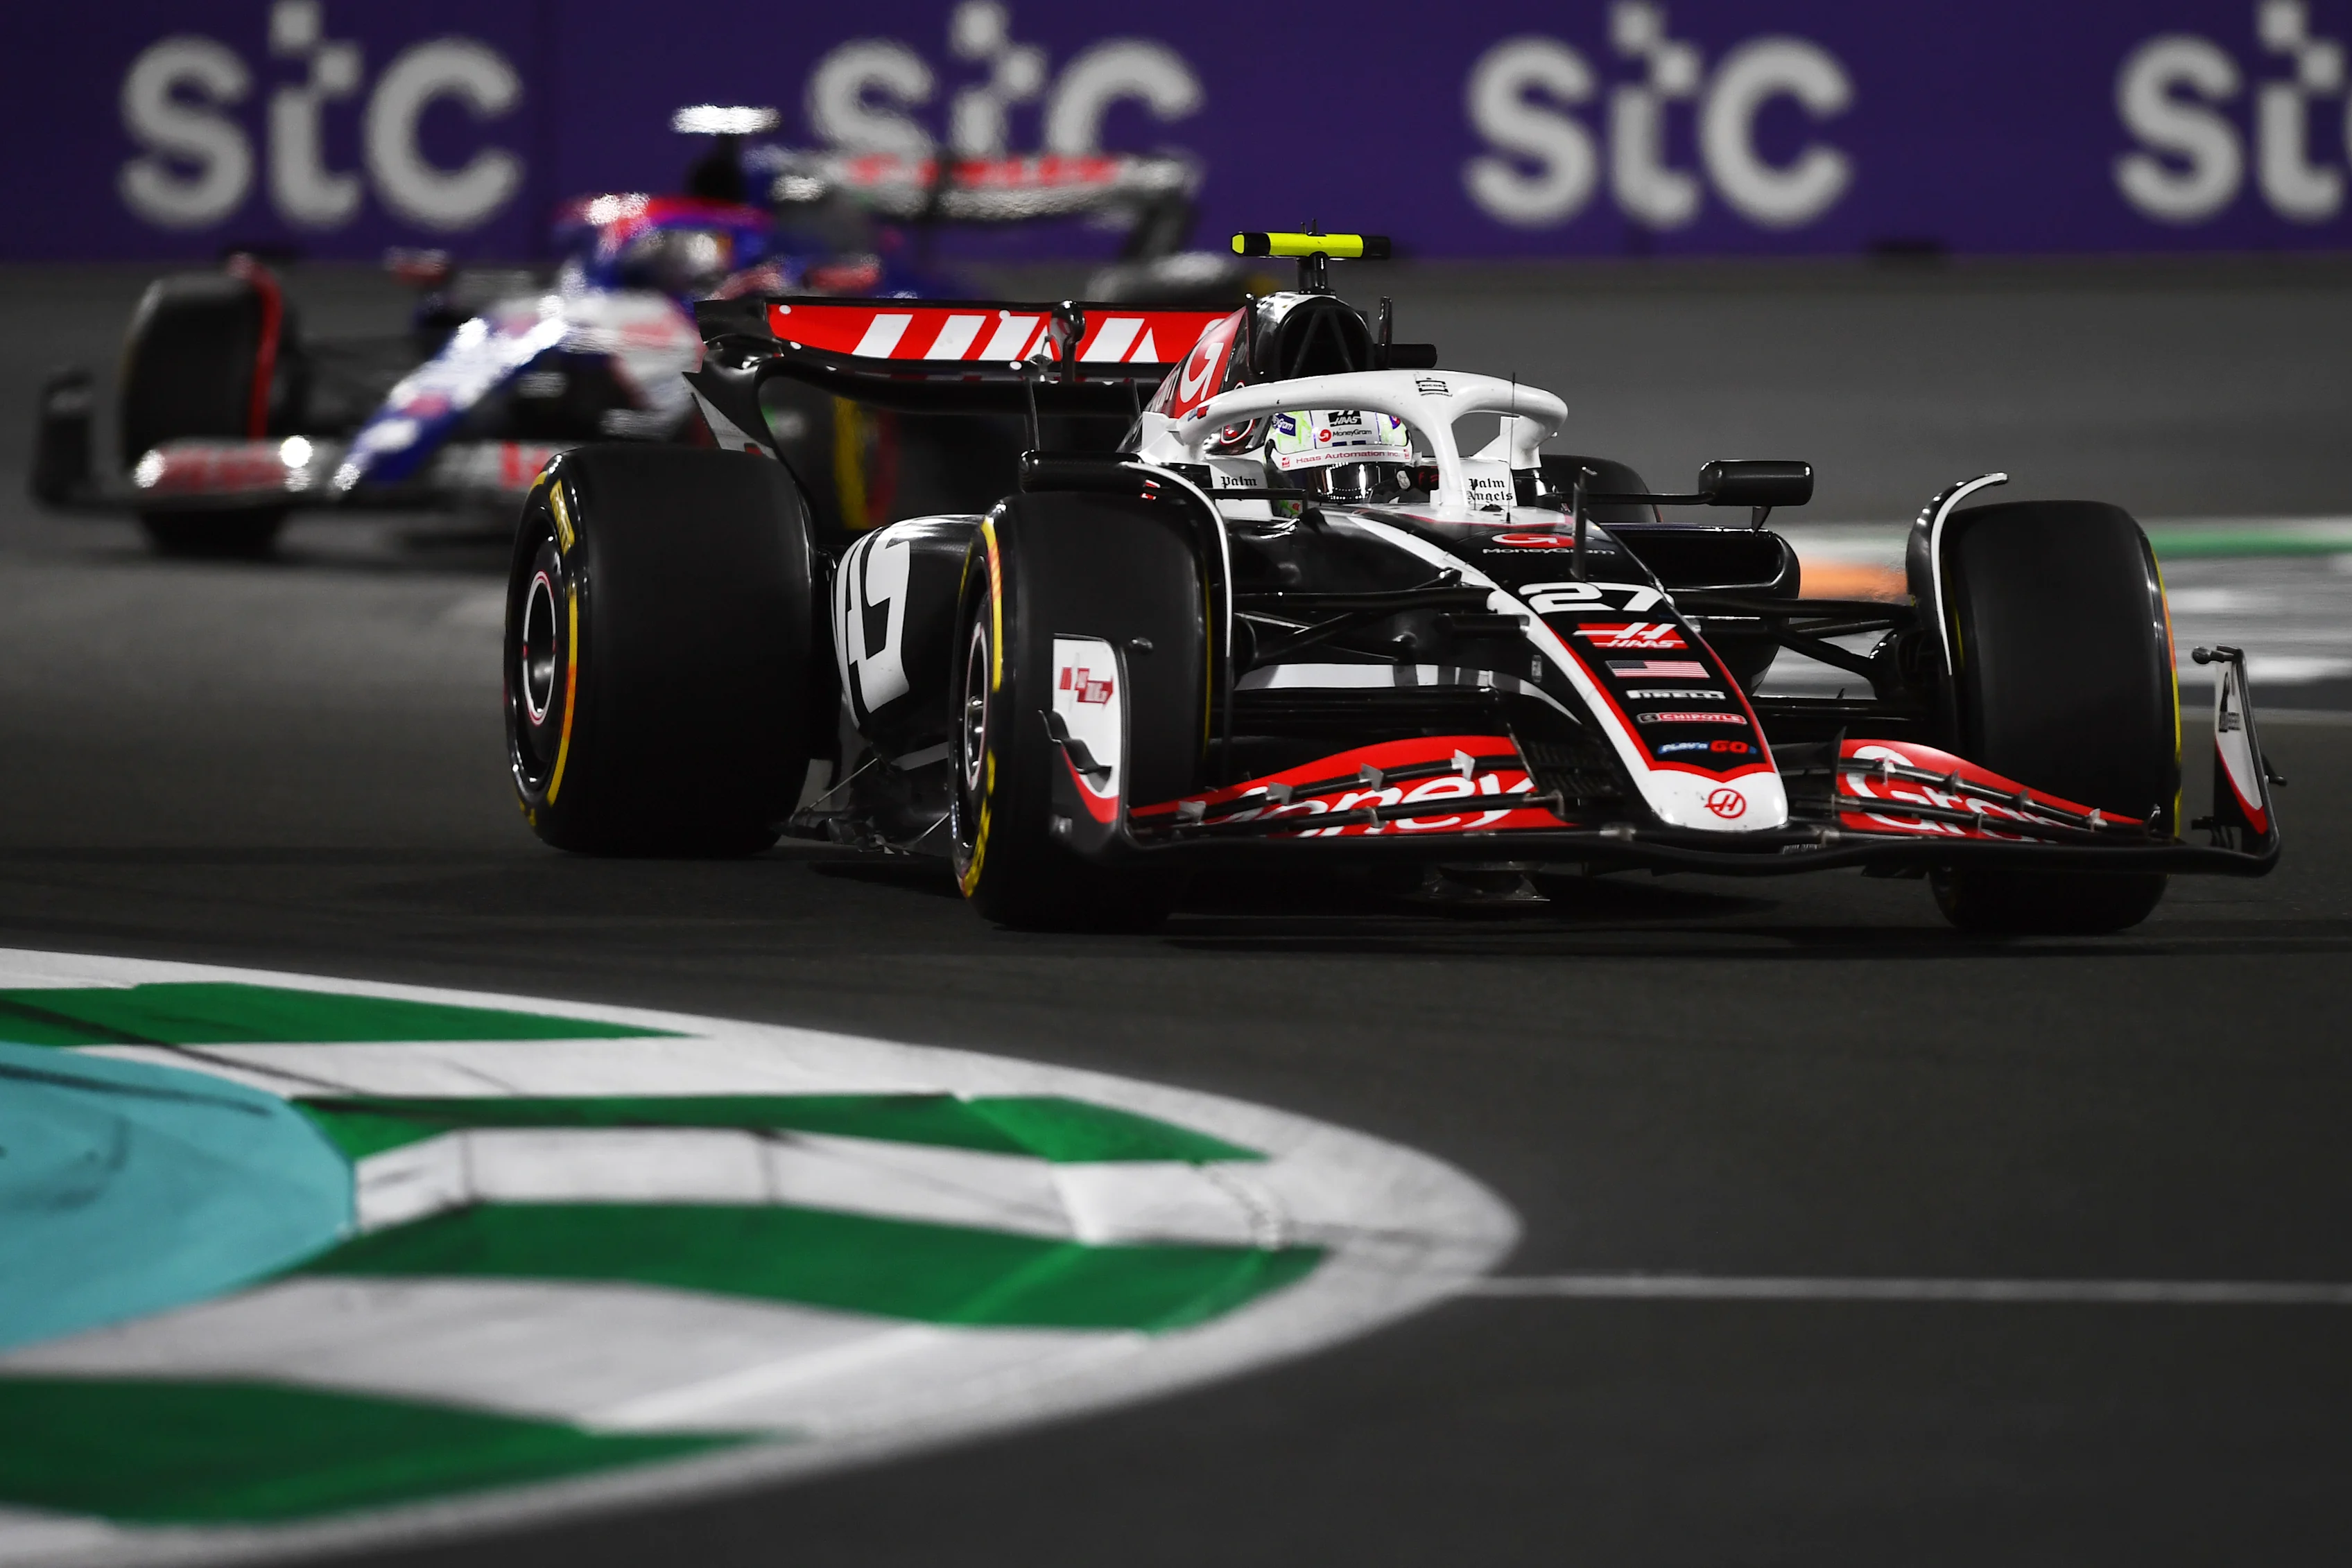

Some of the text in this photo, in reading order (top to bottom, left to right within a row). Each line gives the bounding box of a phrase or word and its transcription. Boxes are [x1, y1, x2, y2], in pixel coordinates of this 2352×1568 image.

[119, 0, 521, 230] stc
[1464, 0, 1853, 227] stc
[2113, 0, 2352, 225] st
[1333, 416, 1358, 425] HAAS
[1332, 428, 1372, 437] MoneyGram
[1296, 455, 1322, 464] Haas
[1325, 451, 1385, 460] Automation
[1220, 476, 1257, 489] Palm
[1468, 478, 1505, 490] Palm
[1467, 491, 1513, 504] Angels
[1519, 582, 1664, 614] 27
[1603, 639, 1678, 648] HAAS
[1627, 690, 1725, 699] PIRELLI
[1663, 713, 1740, 722] CHIPOTLE
[1710, 740, 1748, 753] GO
